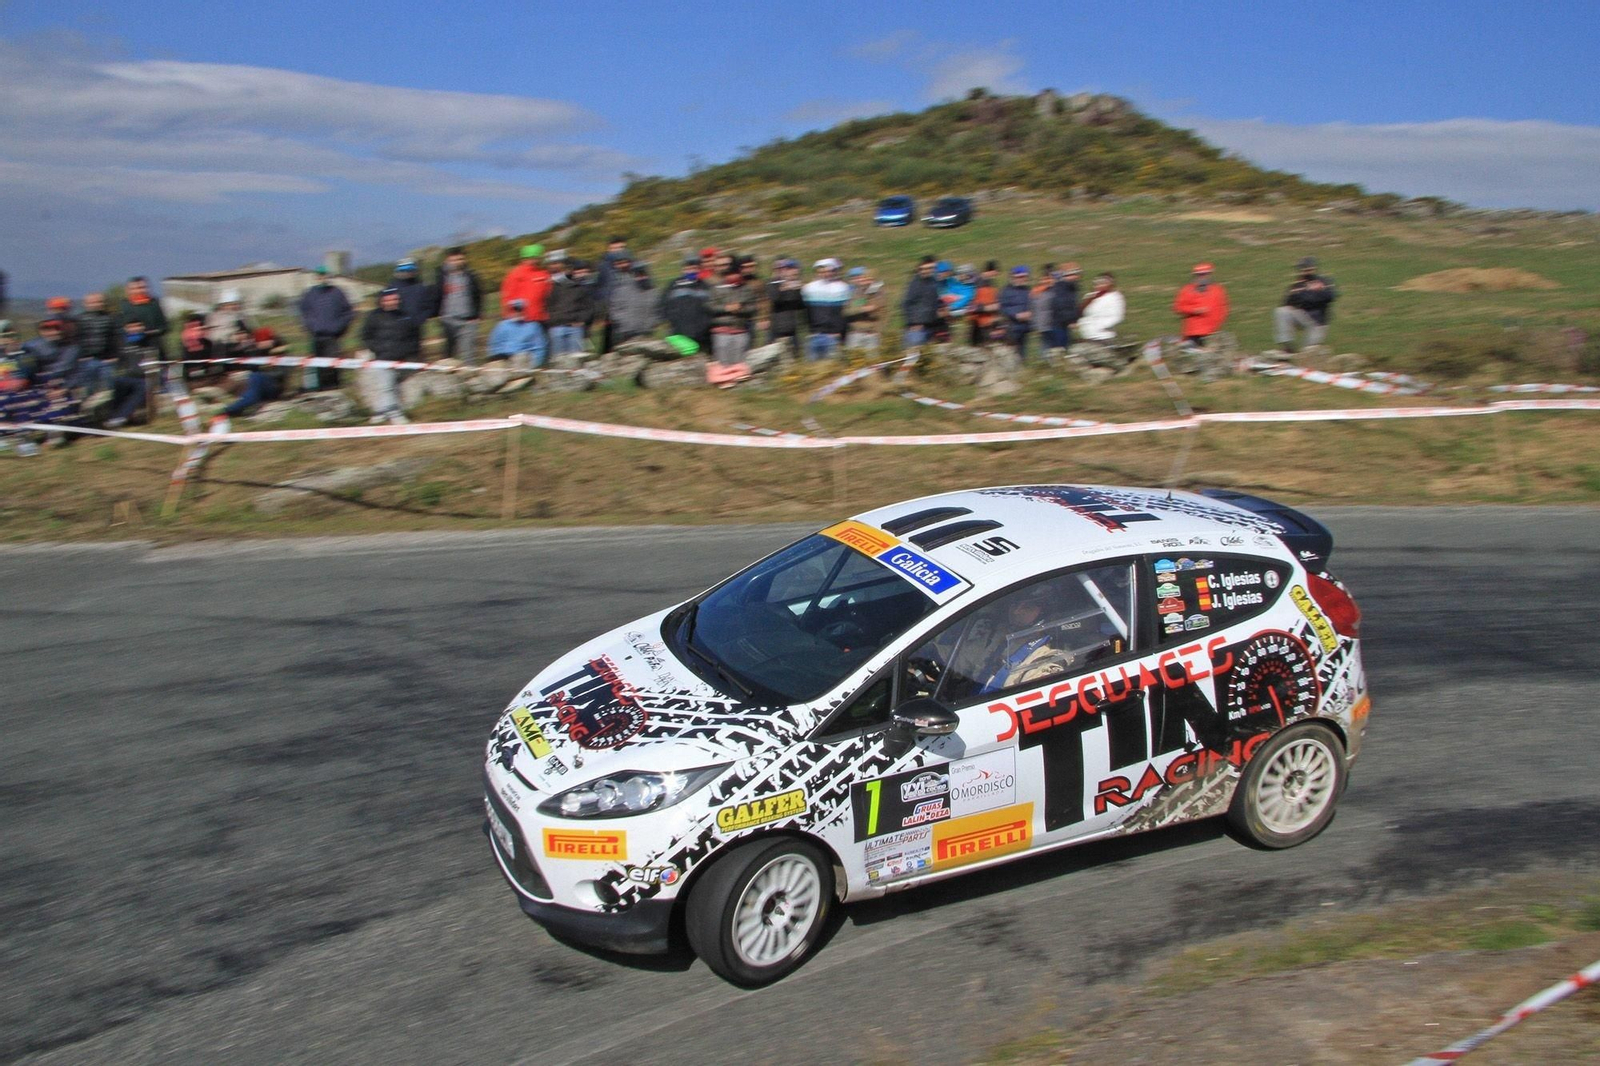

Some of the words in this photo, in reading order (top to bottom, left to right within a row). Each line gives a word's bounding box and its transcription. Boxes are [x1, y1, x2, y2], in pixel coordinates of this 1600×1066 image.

[835, 527, 890, 555] PIRELLI
[890, 552, 942, 587] Galicia
[1207, 573, 1220, 589] C.
[1221, 571, 1261, 590] Iglesias
[1211, 592, 1221, 609] J.
[1222, 591, 1263, 610] Iglesias
[987, 636, 1234, 742] DESGUACES
[717, 790, 806, 827] GALFER
[866, 780, 882, 836] 1
[914, 799, 943, 814] GRUAS
[548, 834, 619, 855] PIRELLI
[937, 820, 1027, 861] PIRELLI
[629, 867, 661, 883] elf
